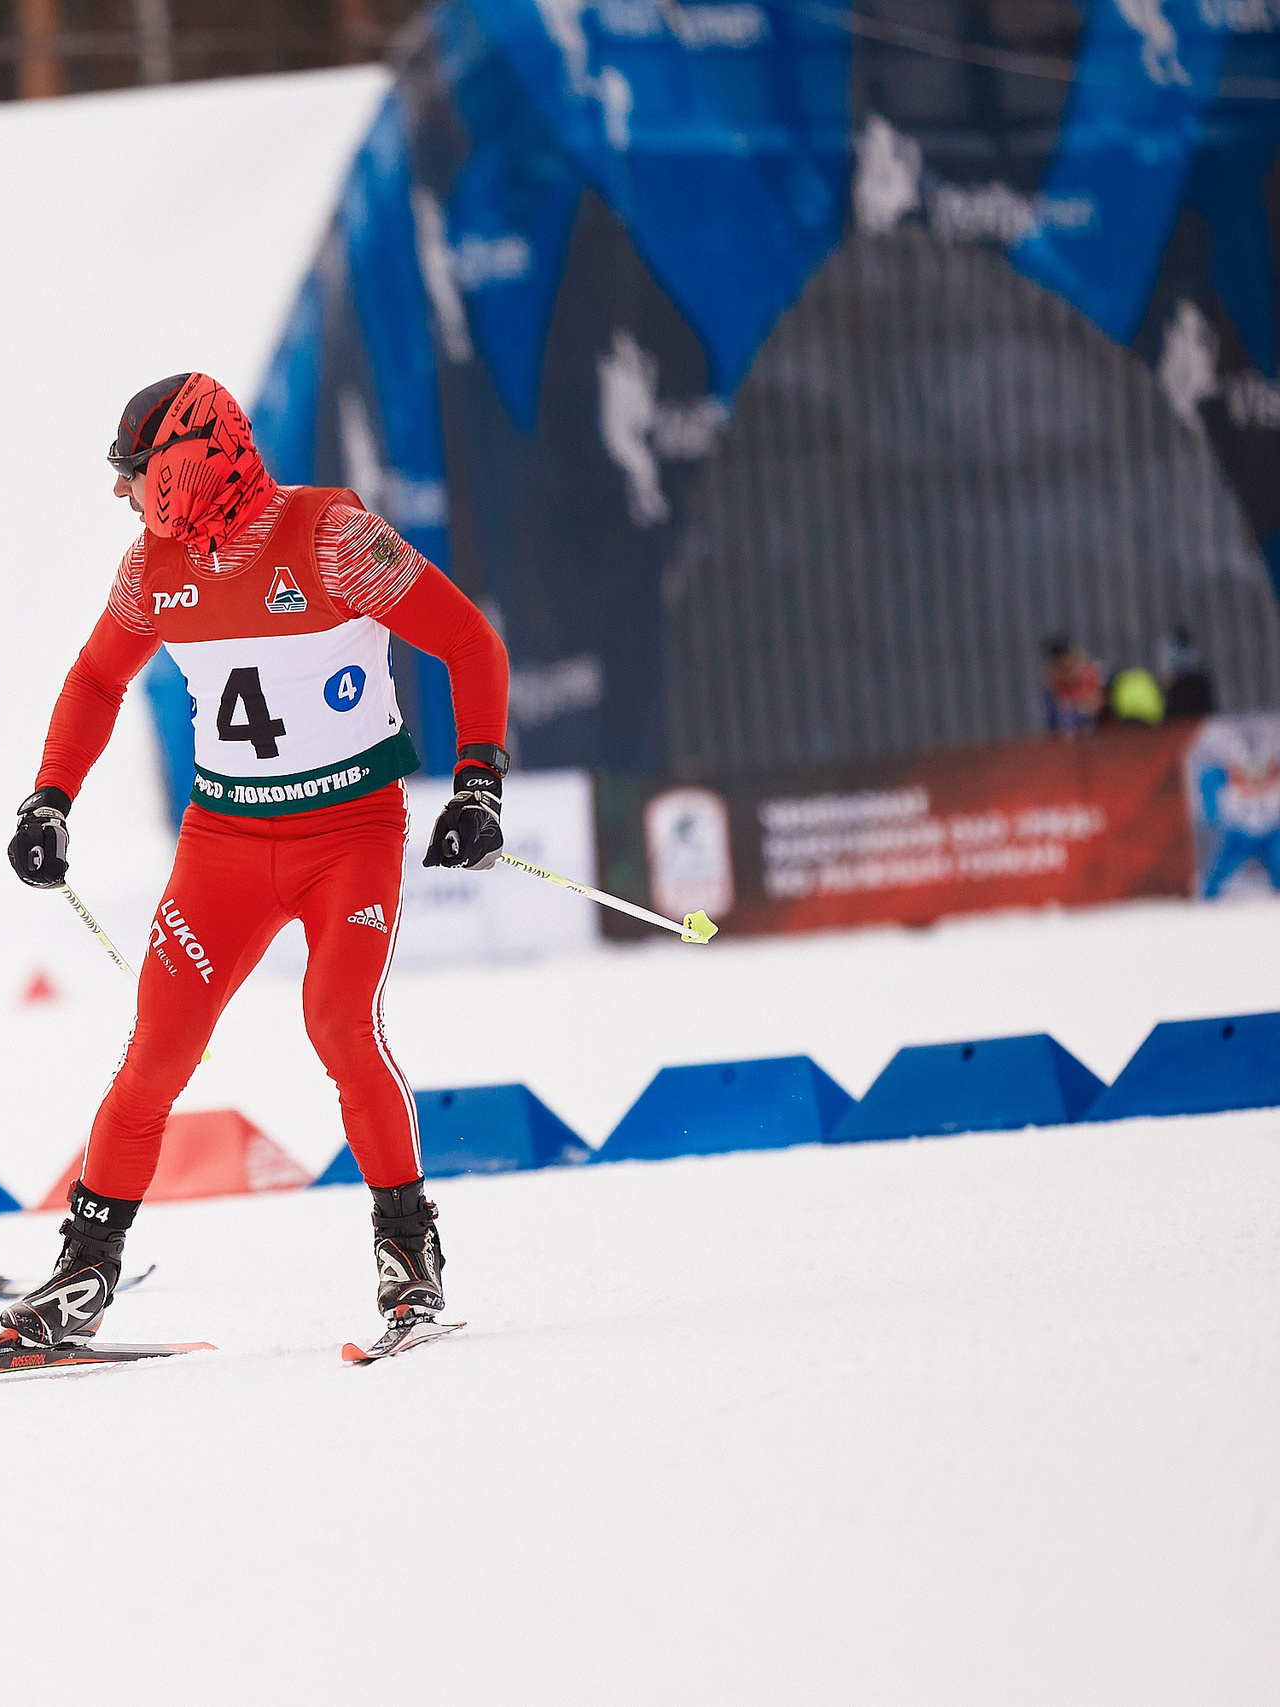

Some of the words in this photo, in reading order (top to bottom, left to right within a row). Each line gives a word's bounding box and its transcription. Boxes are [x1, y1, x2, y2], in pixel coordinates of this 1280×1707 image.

[337, 671, 358, 702] 4
[217, 667, 287, 760] 4
[227, 765, 371, 804] «ЛОКОМОТИВ»
[160, 898, 214, 984] LUKOIL
[346, 914, 388, 934] adidas
[156, 947, 178, 977] RUSAL
[76, 1196, 111, 1224] 154
[30, 1277, 101, 1328] R
